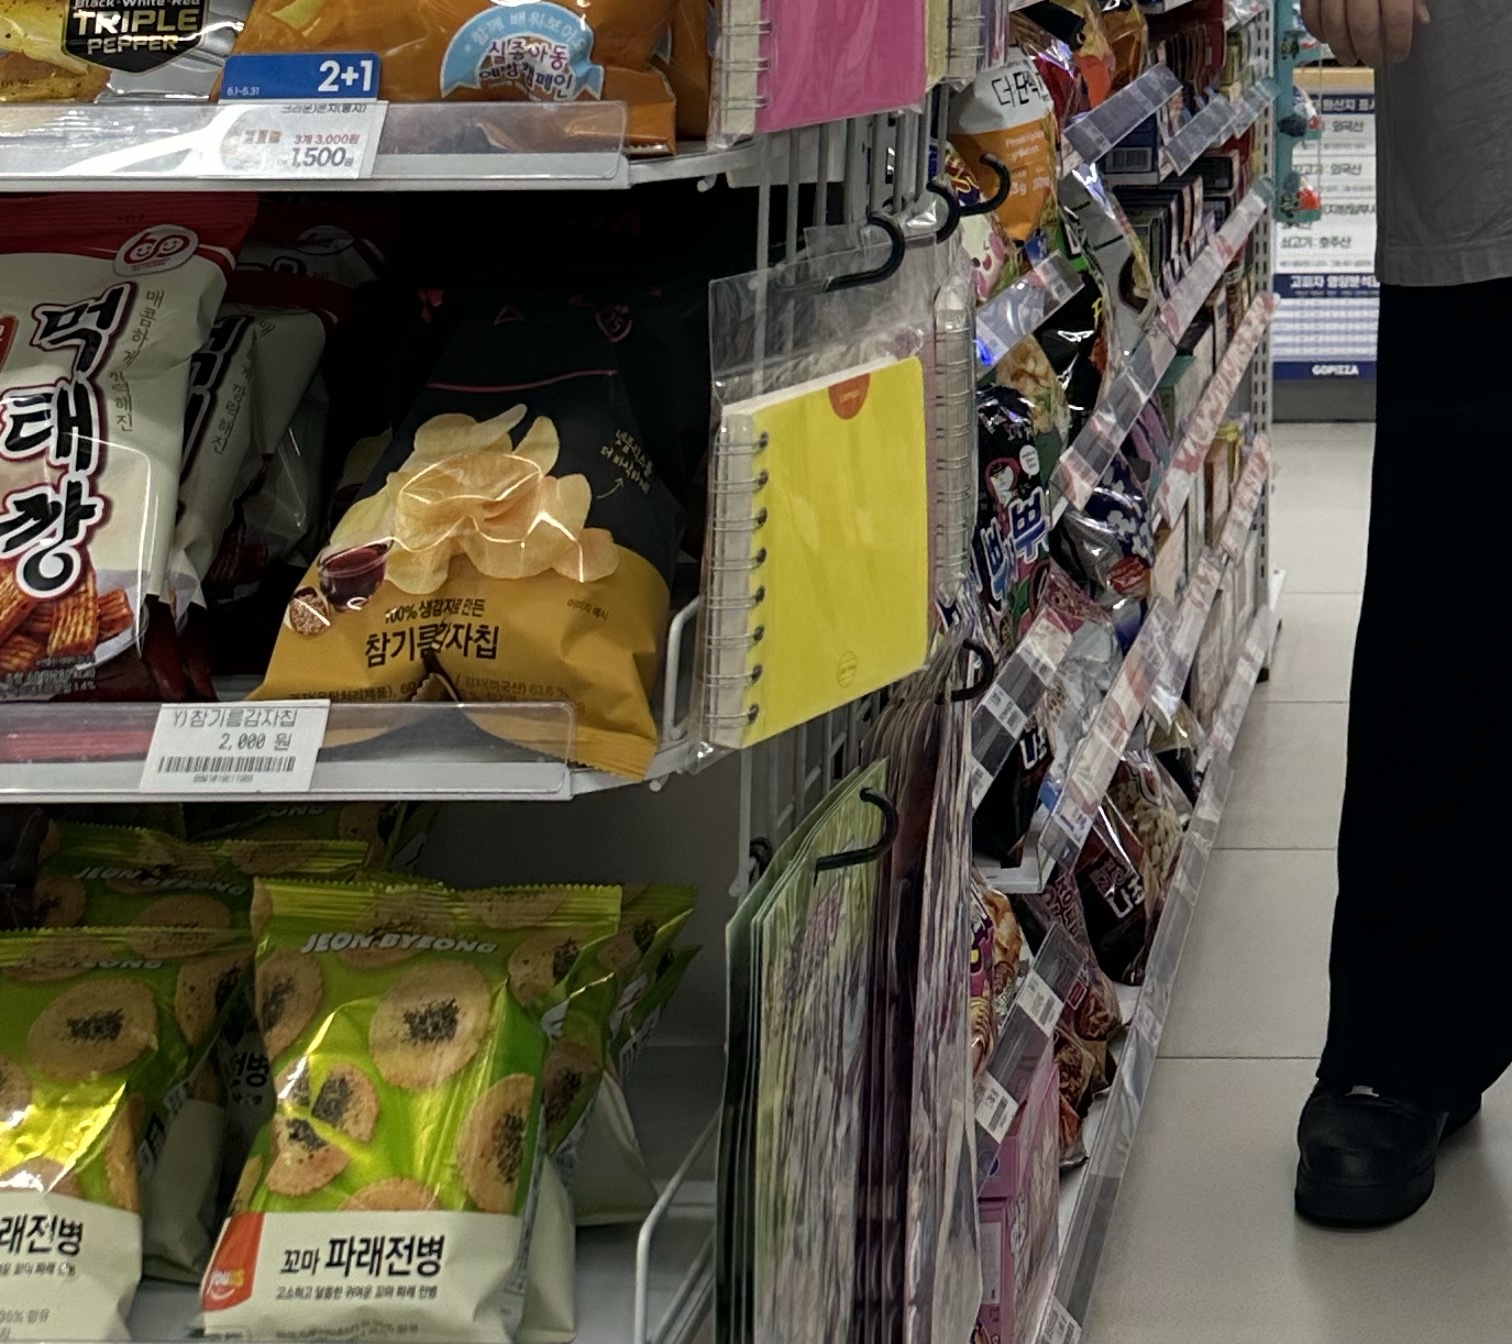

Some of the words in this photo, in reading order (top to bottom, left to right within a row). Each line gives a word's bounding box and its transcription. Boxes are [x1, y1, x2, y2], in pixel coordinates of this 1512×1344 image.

[72, 8, 200, 35] TRIPLE
[86, 34, 179, 55] PEPPER
[317, 59, 374, 93] 2+1
[0, 283, 130, 596] 먹태깡
[218, 732, 267, 751] 2,000
[274, 733, 293, 752] 원
[279, 1247, 320, 1277] 꼬마
[324, 1234, 446, 1278] 파래전병
